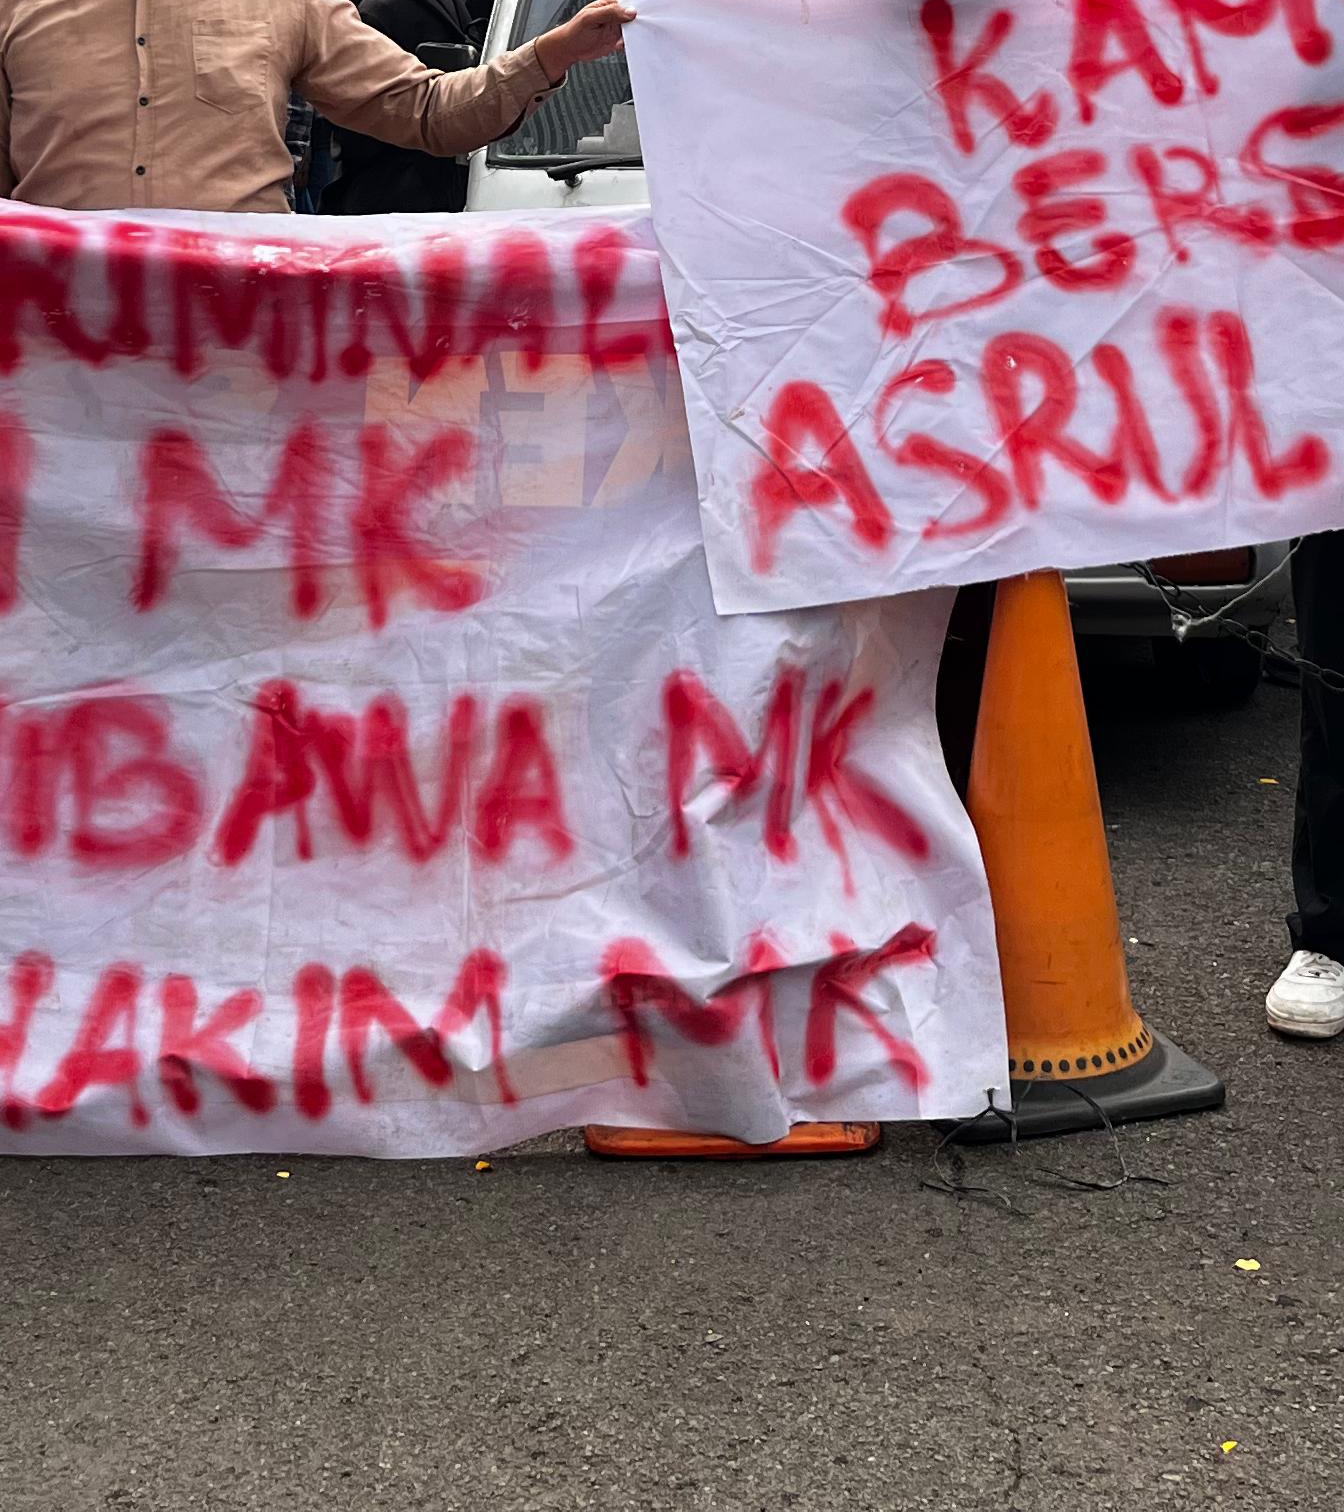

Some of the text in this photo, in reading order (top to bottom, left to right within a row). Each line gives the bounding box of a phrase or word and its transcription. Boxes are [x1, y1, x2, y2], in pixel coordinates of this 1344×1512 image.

[131, 408, 486, 631] MK
[749, 303, 1333, 575] ASRUL
[661, 666, 934, 876] MK
[599, 921, 937, 1092] MK
